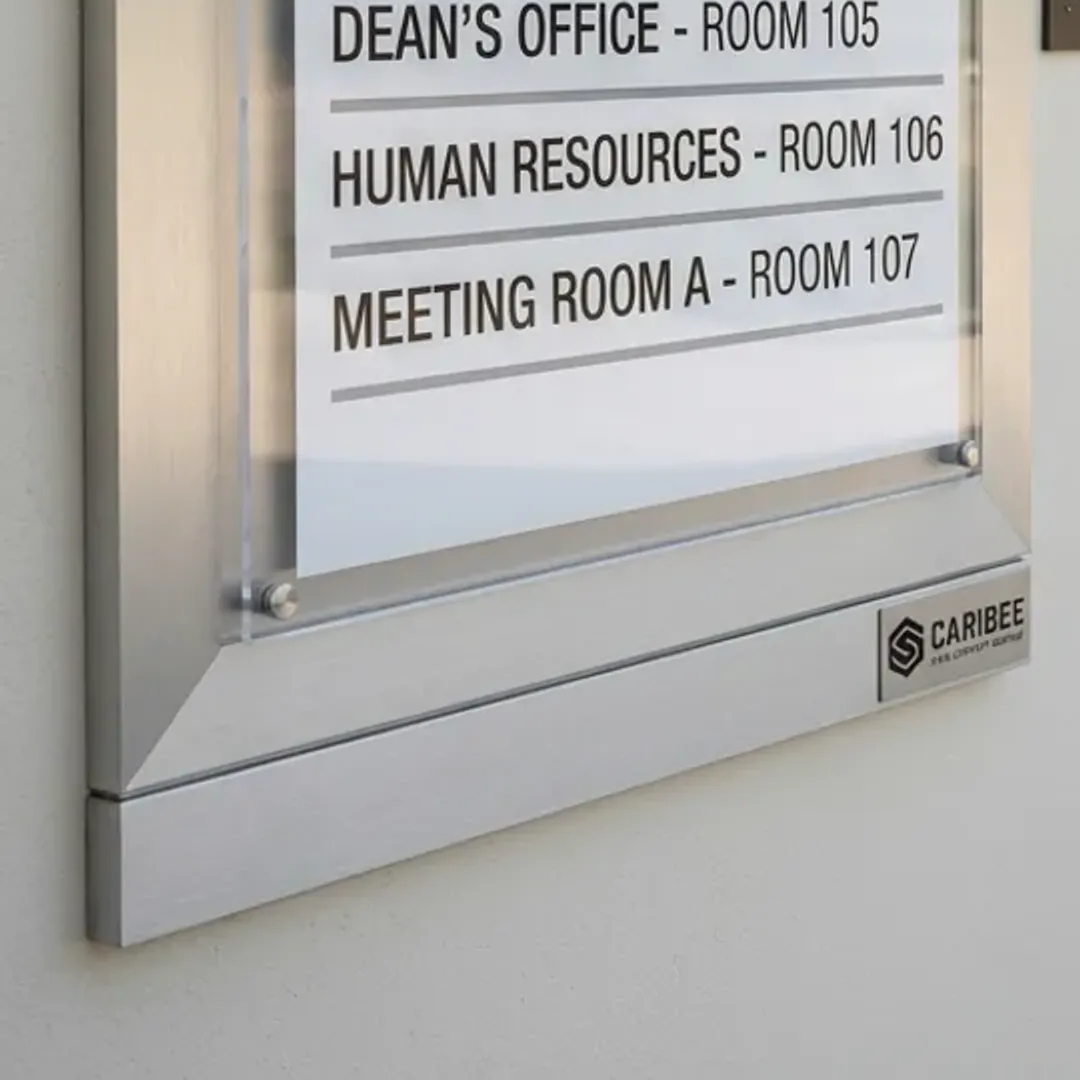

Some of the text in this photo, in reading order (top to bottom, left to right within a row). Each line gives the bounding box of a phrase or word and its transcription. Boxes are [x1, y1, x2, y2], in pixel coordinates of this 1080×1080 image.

[519, 2, 658, 57] OFFICE
[674, 27, 688, 36] -
[704, 1, 806, 51] ROOM
[823, 1, 878, 48] 105
[334, 115, 942, 207] HUMAN RESOURCES - ROOM 106
[335, 233, 918, 351] MEETING ROOM A - ROOM 107
[932, 598, 1024, 649] CARIBEE
